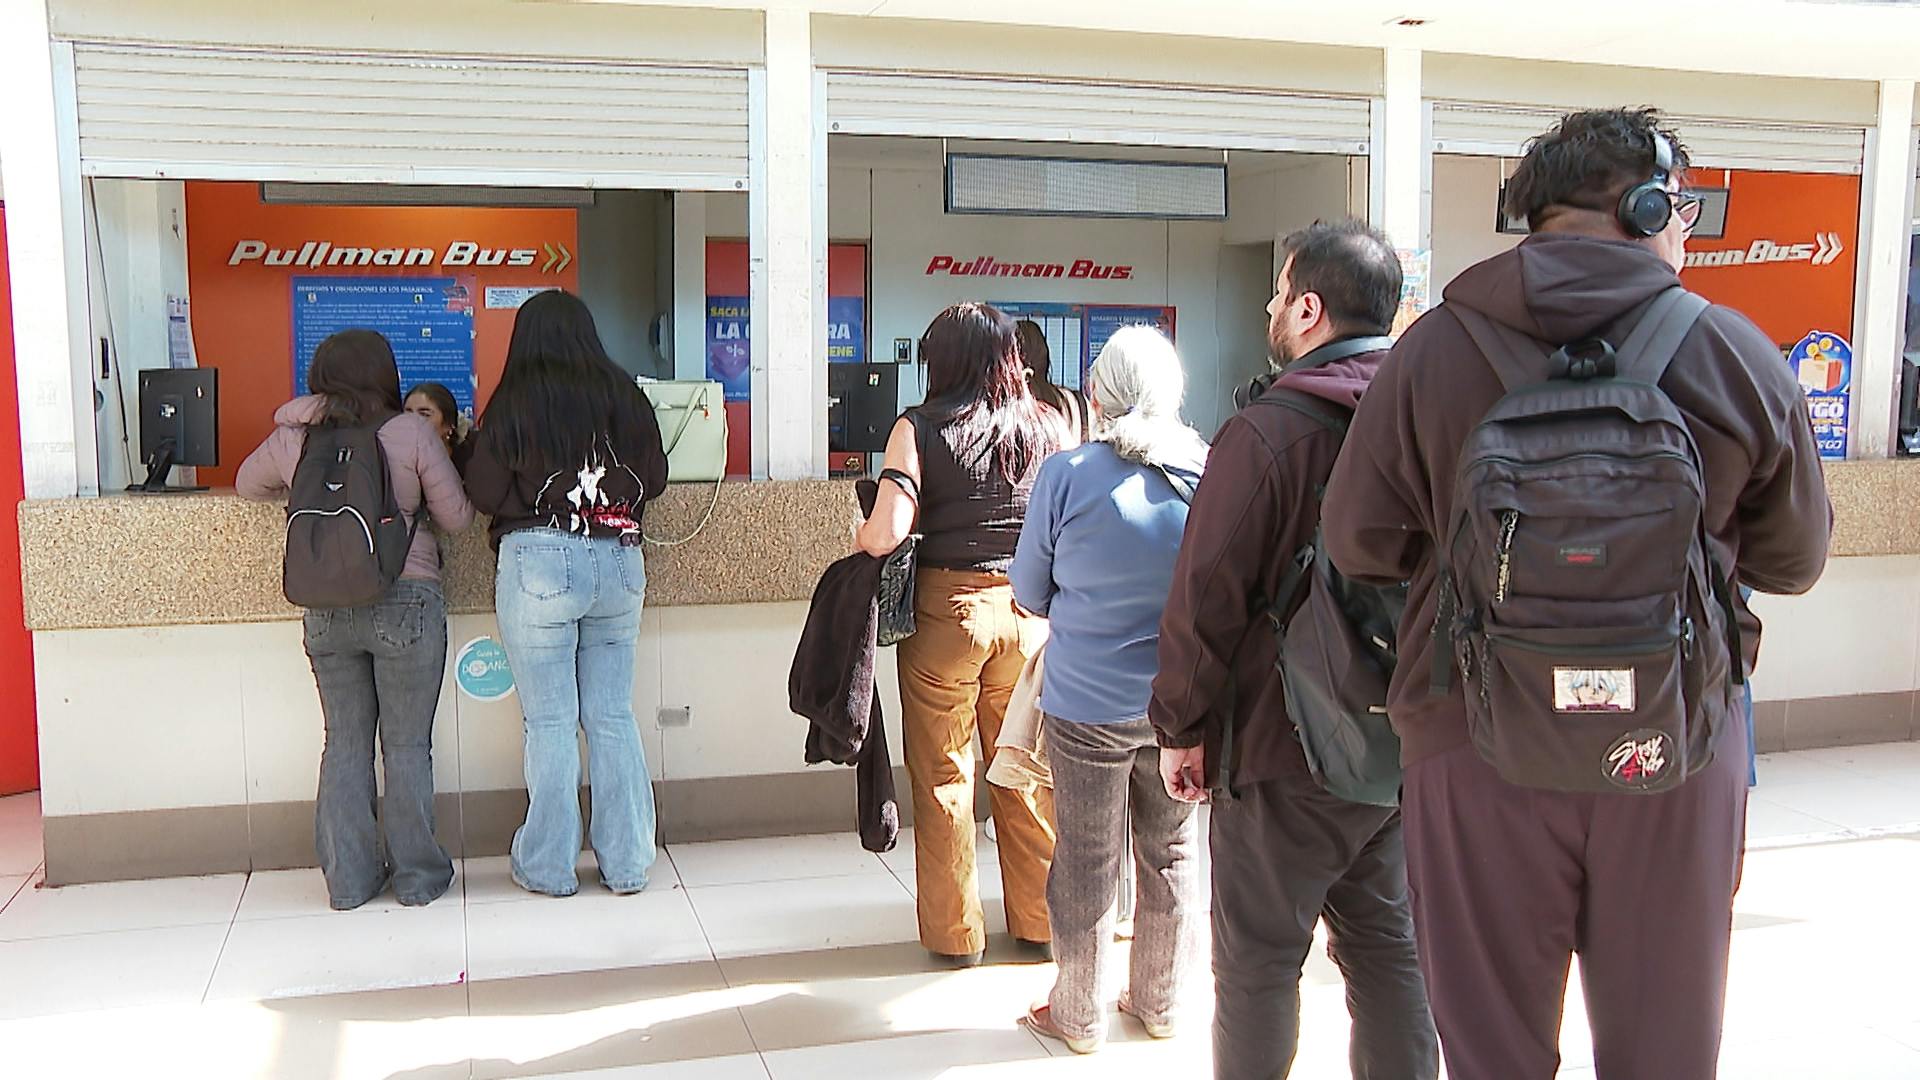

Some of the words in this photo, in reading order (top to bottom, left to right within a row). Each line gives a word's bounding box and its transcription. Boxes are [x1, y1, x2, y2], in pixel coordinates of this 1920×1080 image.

[228, 240, 434, 268] Pullman
[441, 241, 538, 266] Bus
[1745, 240, 1815, 264] Bus
[925, 255, 1064, 279] Pullman
[710, 306, 738, 318] SACA
[741, 307, 750, 318] L
[715, 321, 741, 340] LA
[828, 322, 851, 340] RA
[828, 345, 855, 358] ENE
